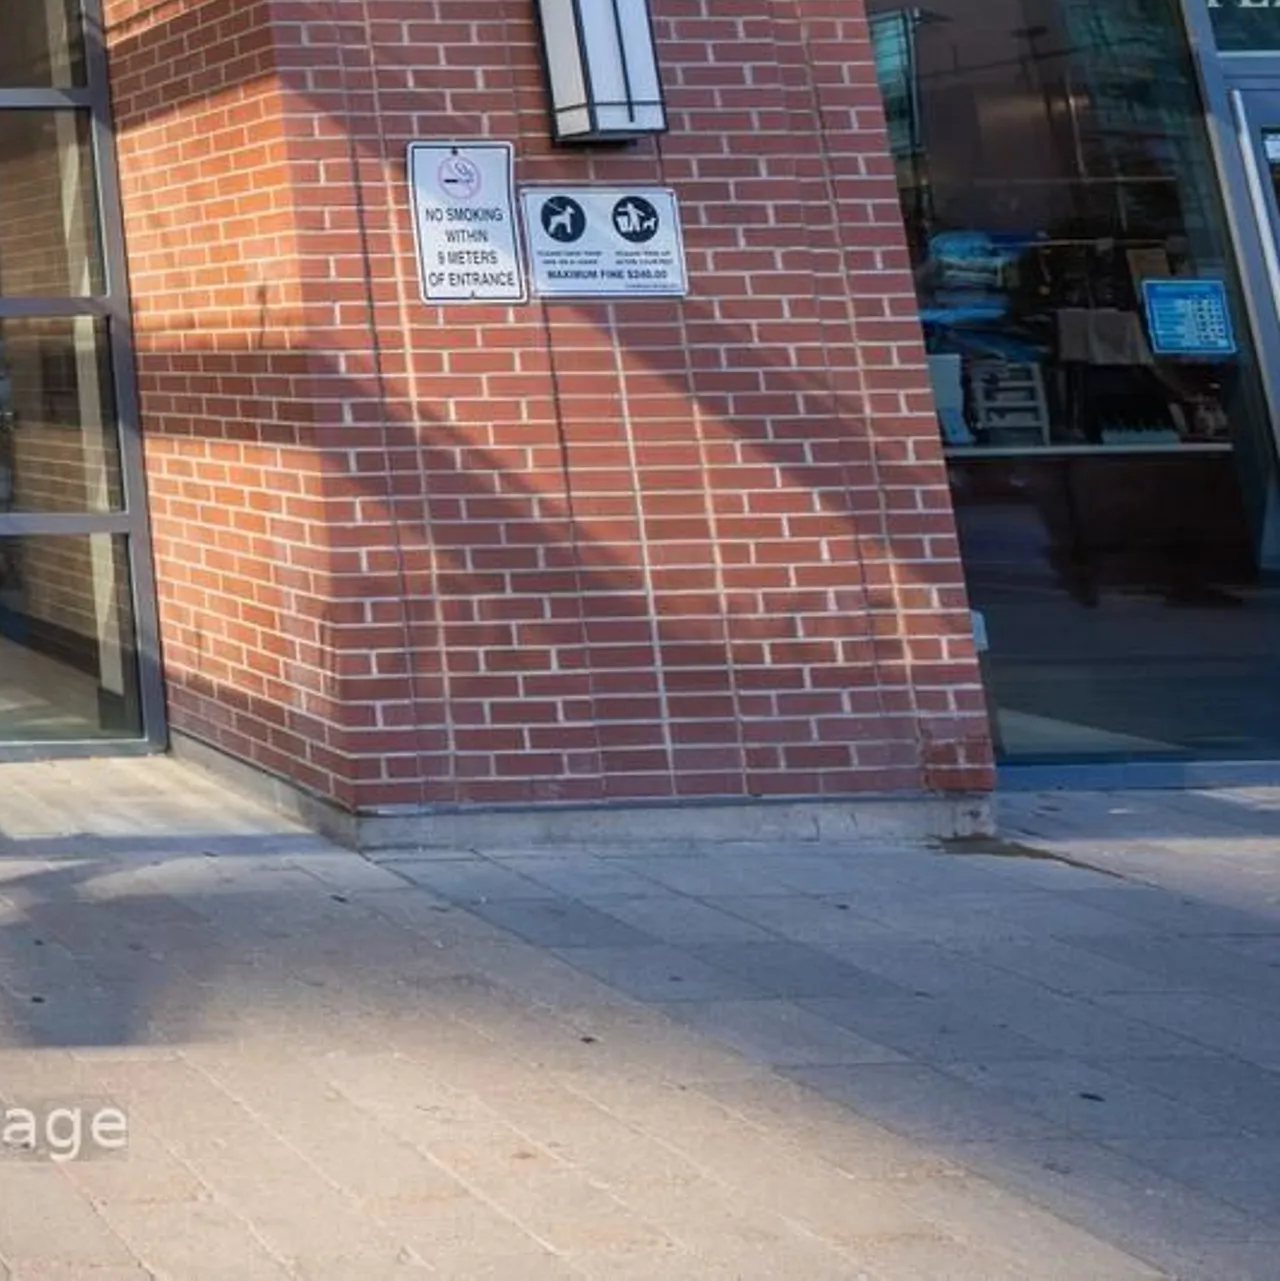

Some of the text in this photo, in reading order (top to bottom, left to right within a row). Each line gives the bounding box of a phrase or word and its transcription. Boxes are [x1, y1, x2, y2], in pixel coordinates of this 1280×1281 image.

[425, 207, 504, 221] NO SMOKING
[445, 229, 489, 243] WITHIN
[447, 250, 499, 265] METERS
[427, 271, 516, 287] OF ENTRANCE
[547, 269, 598, 279] MAXIMUM
[600, 269, 625, 279] FINE
